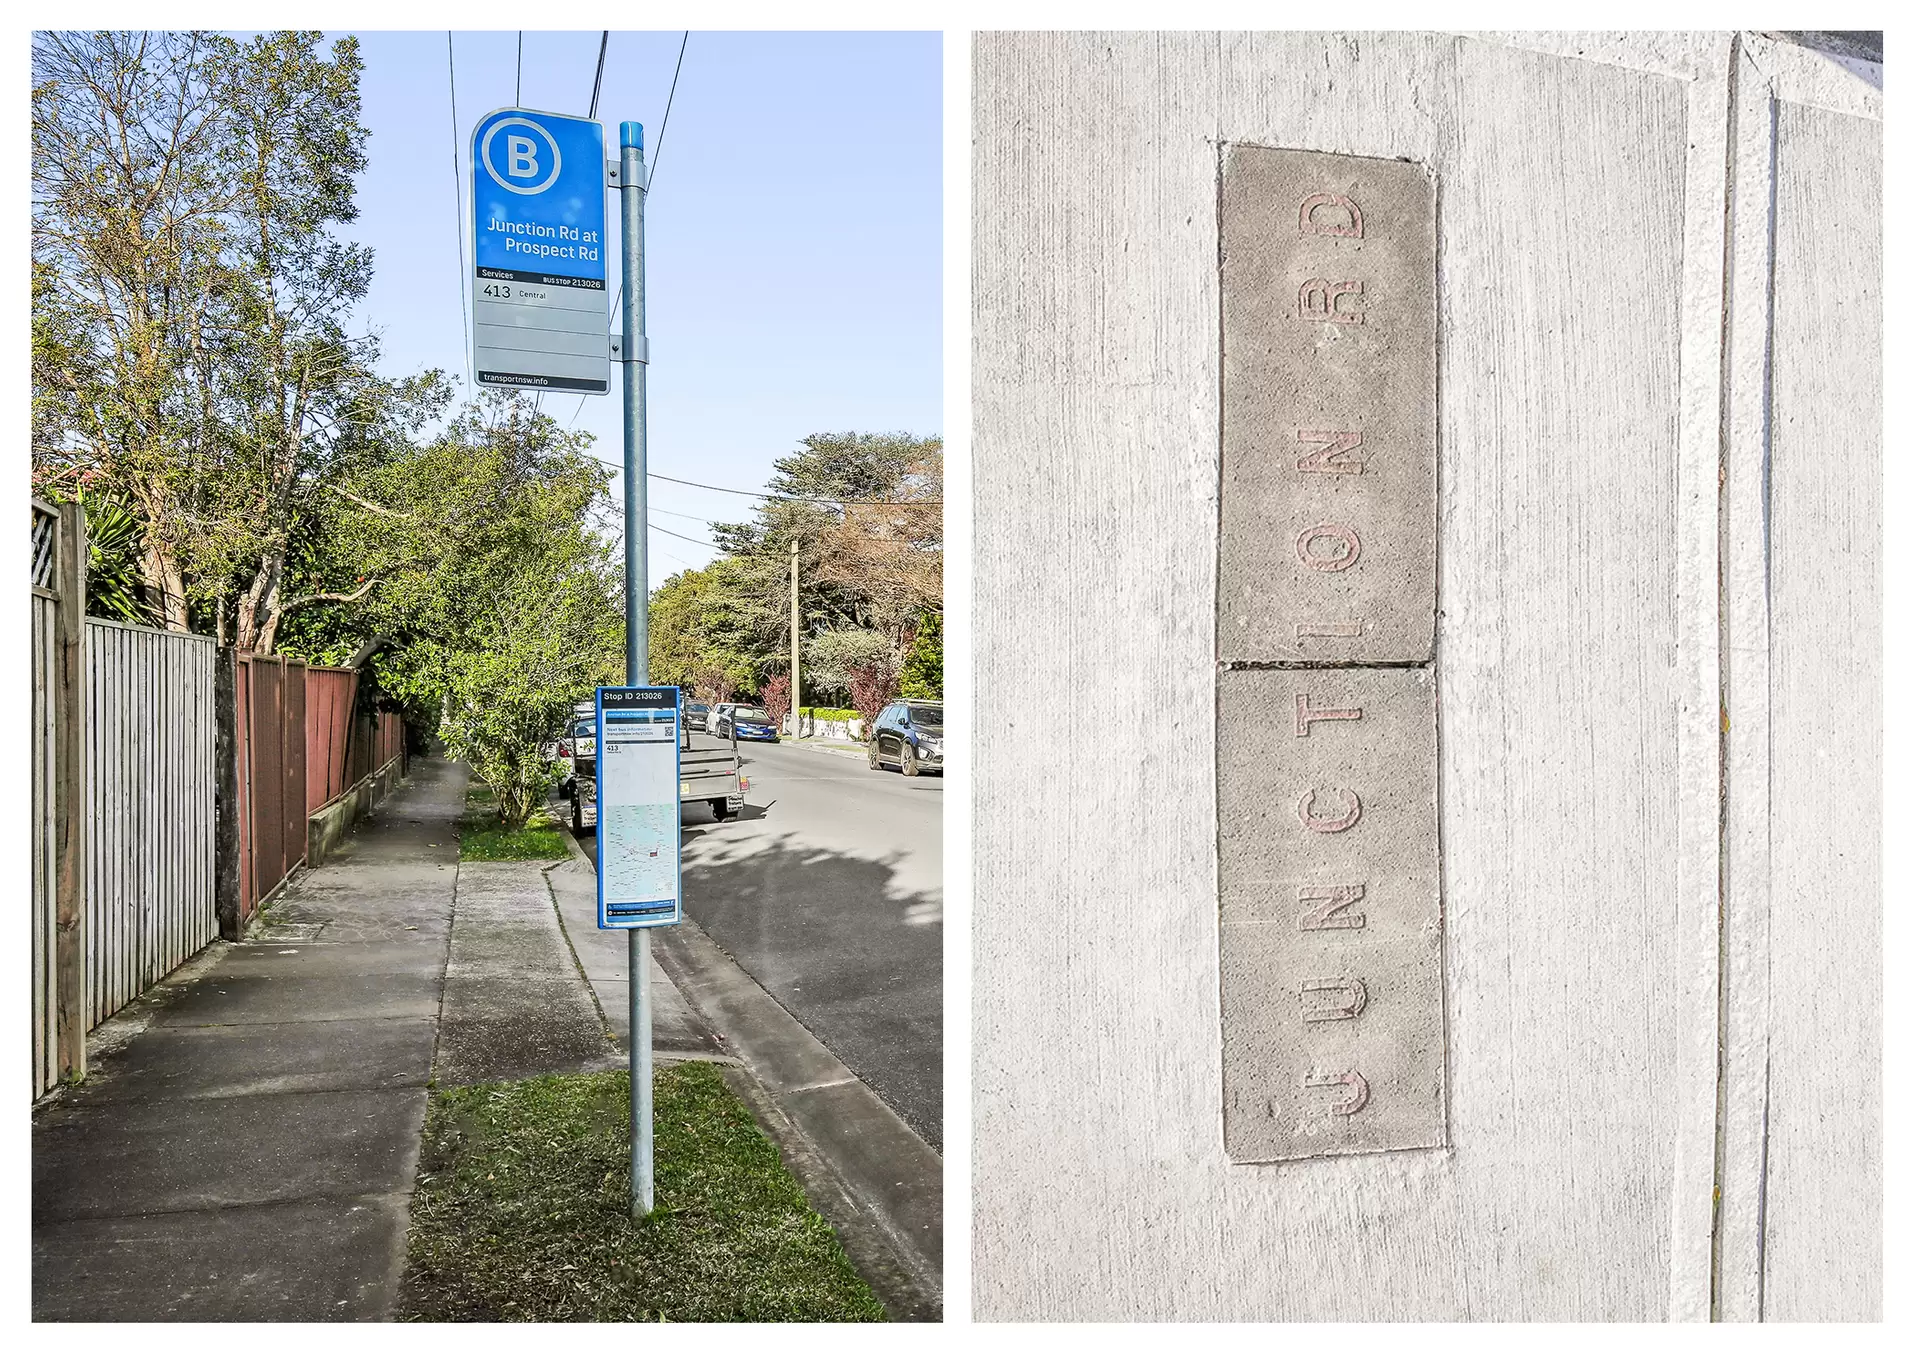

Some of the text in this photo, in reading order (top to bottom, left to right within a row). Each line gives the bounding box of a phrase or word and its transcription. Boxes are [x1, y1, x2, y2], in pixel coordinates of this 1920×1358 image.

[508, 135, 539, 178] B
[487, 217, 598, 243] Junction Rd at
[505, 237, 598, 262] Prospect Rd
[482, 269, 514, 280] Services
[543, 276, 555, 284] BUS
[572, 280, 601, 289] 213026
[483, 284, 546, 299] 413 Central
[484, 373, 548, 386] transportnsw.info
[1296, 191, 1369, 1116] JUNCTION RD
[604, 692, 663, 701] Stop ID 213026
